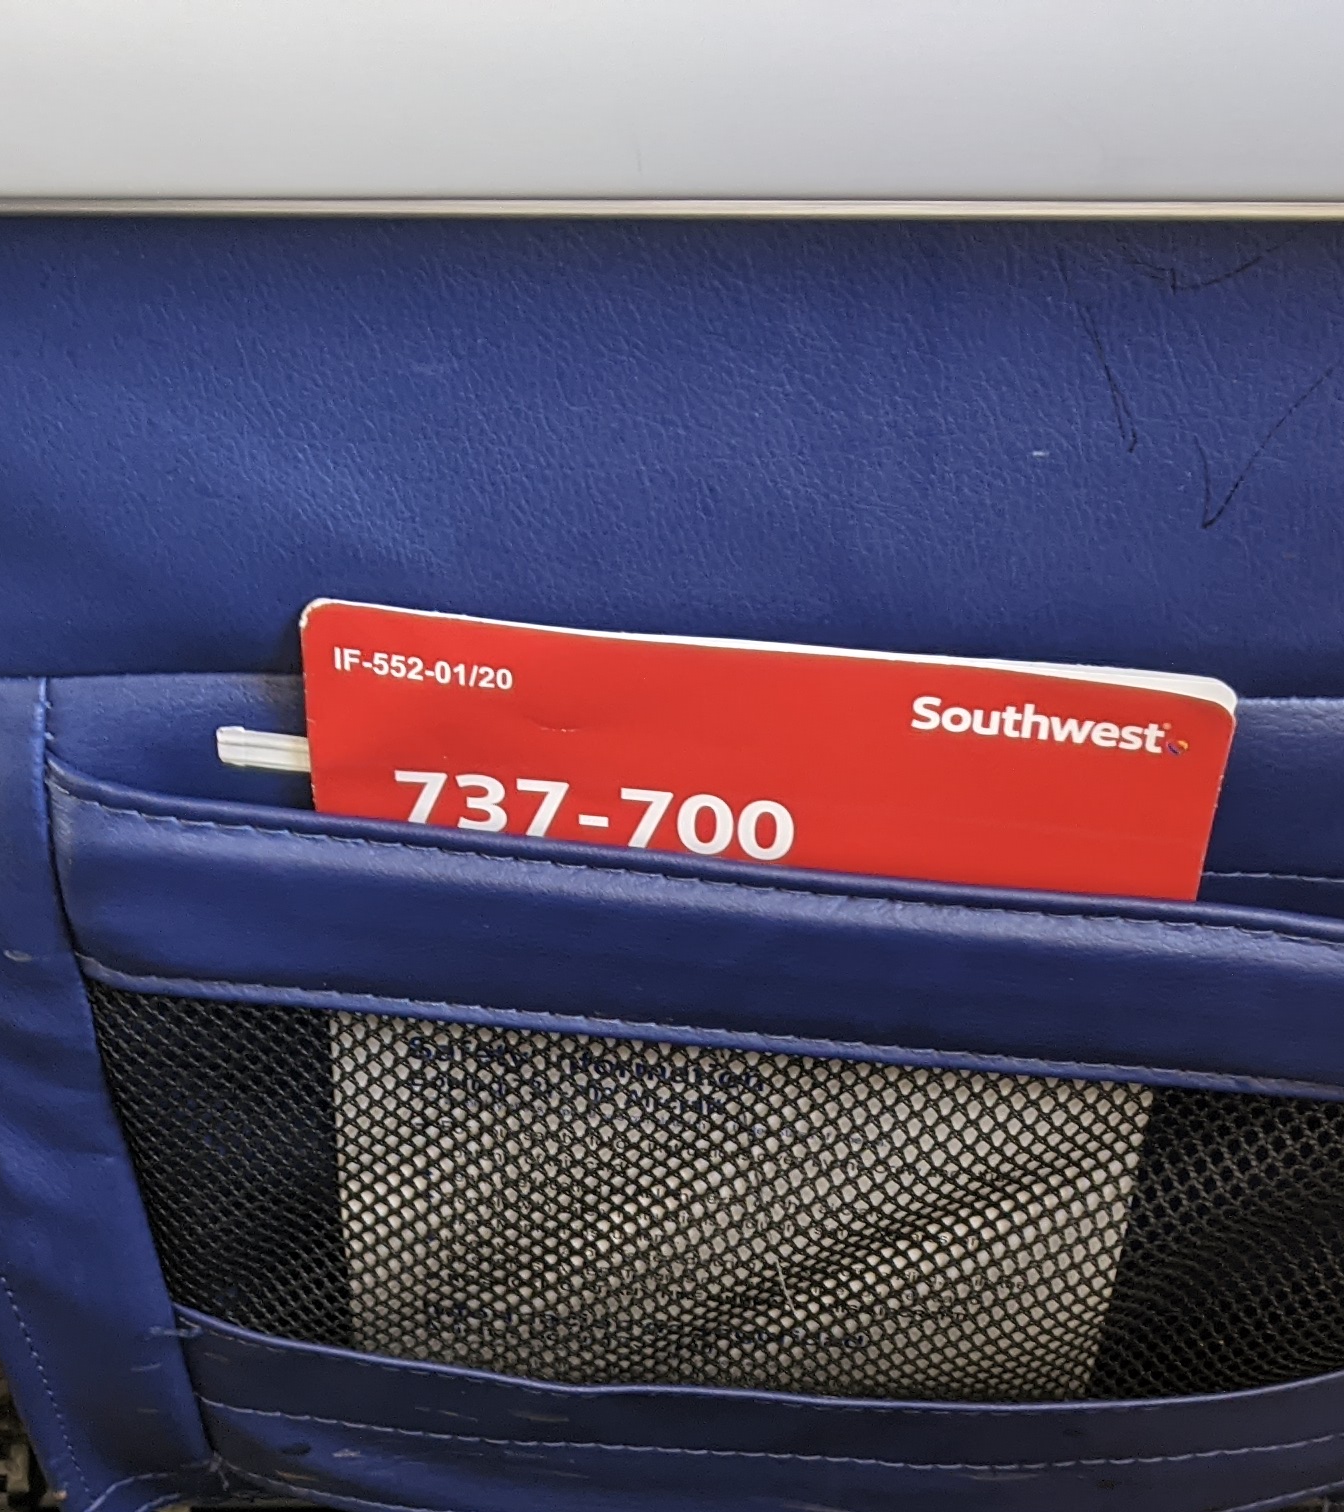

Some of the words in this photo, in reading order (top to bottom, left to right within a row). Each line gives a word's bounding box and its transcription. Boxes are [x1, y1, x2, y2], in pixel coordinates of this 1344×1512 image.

[333, 646, 513, 690] IF-552-01/20
[910, 695, 1166, 754] Southwest
[393, 769, 795, 861] 737-700
